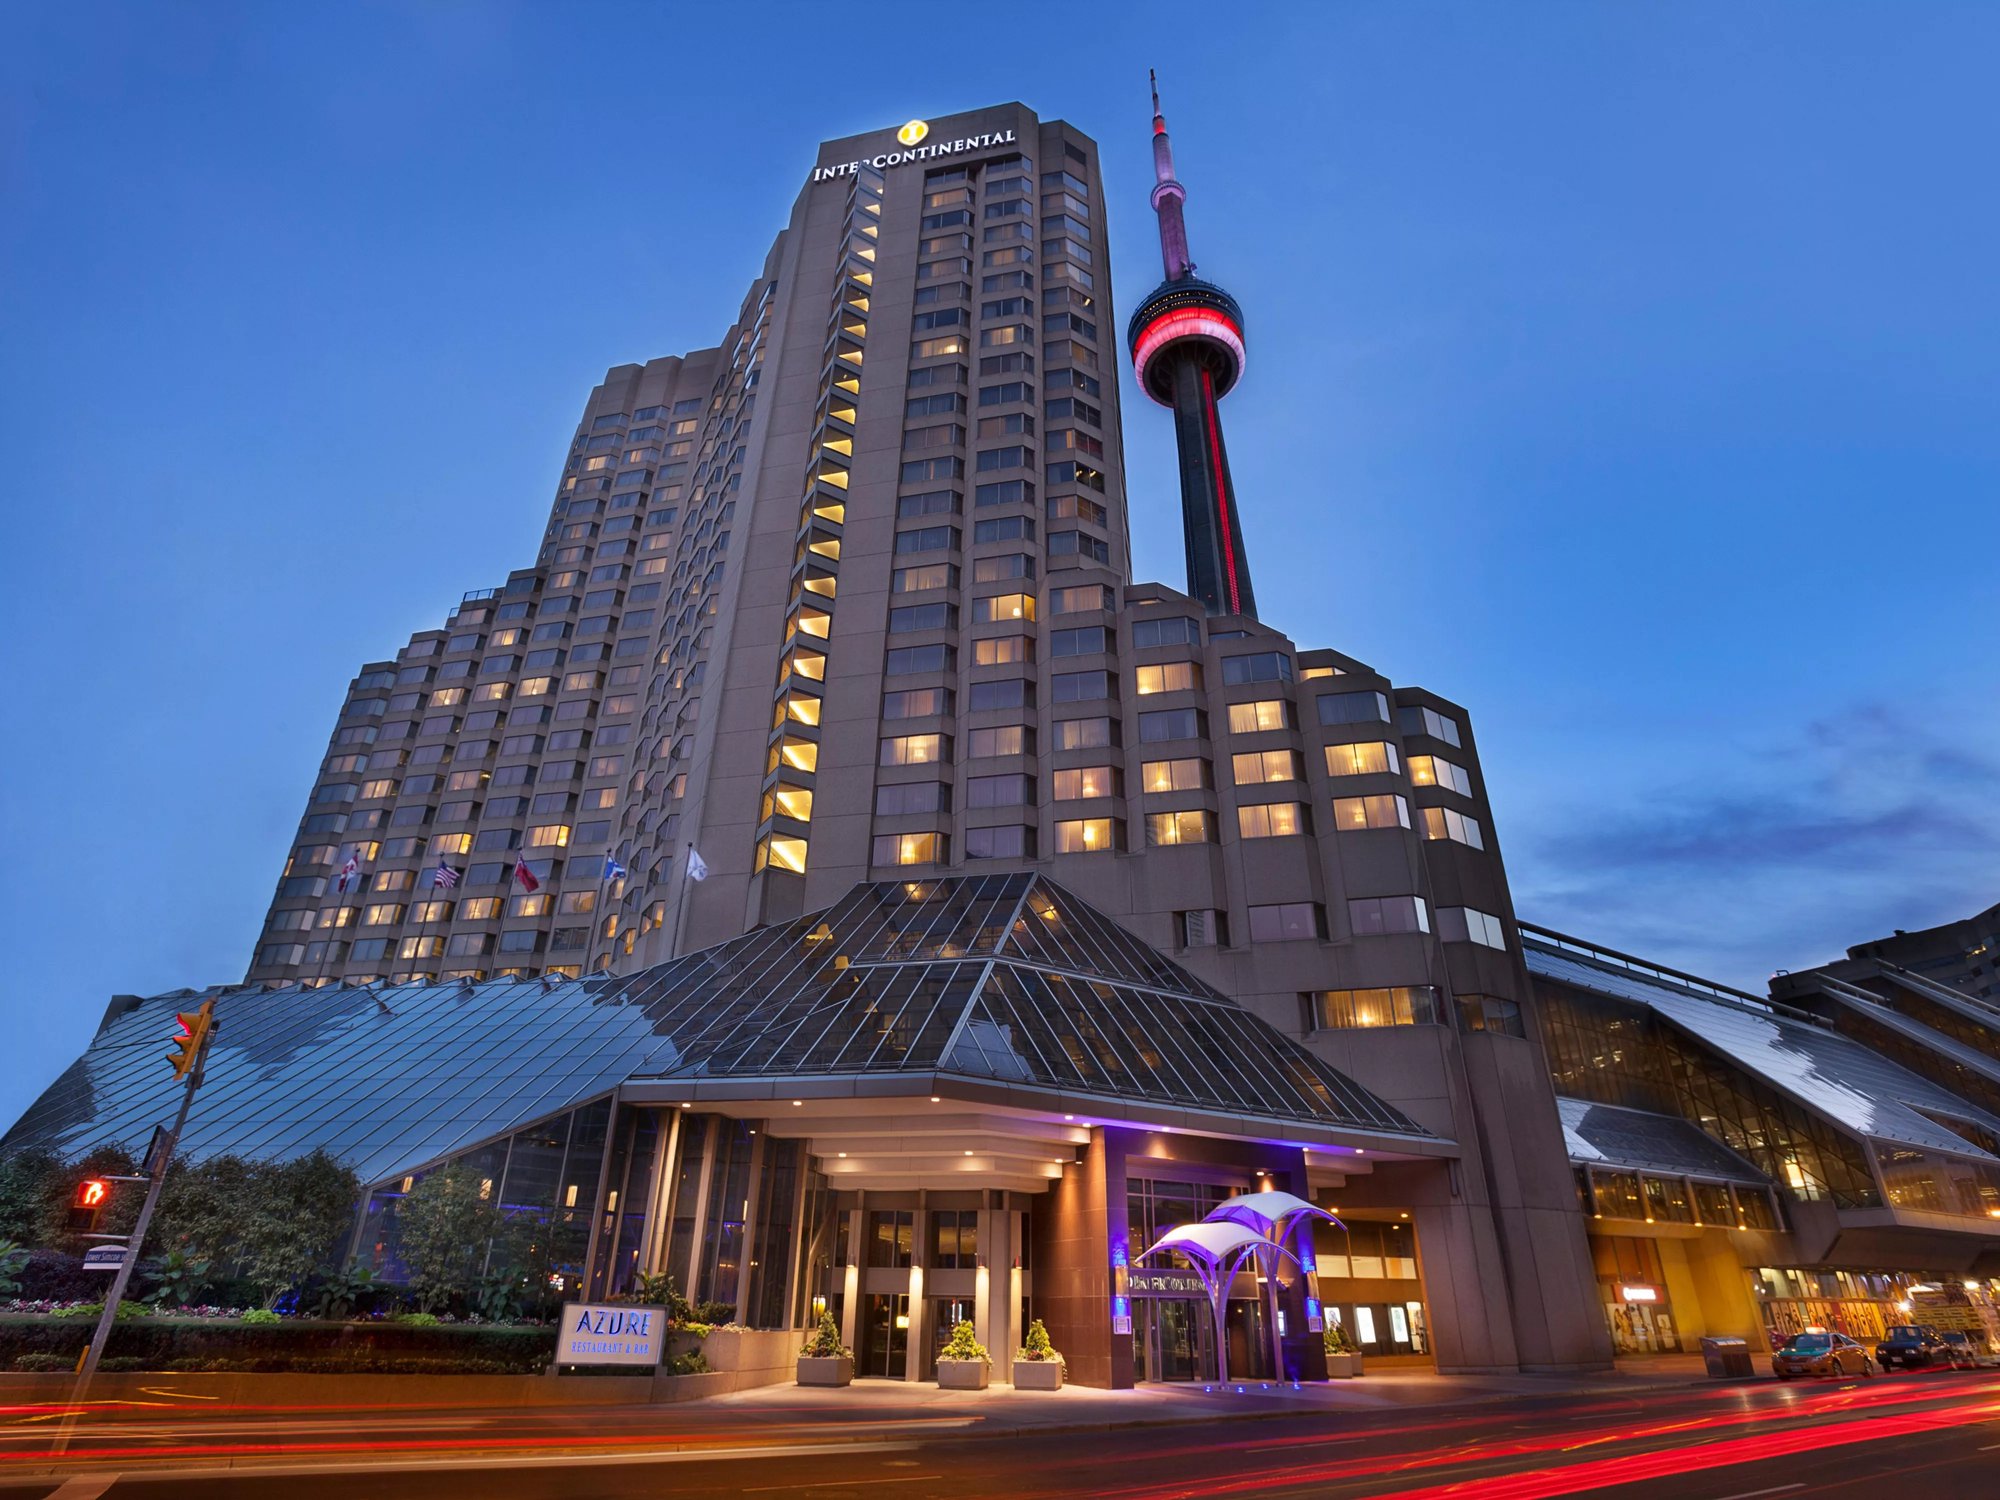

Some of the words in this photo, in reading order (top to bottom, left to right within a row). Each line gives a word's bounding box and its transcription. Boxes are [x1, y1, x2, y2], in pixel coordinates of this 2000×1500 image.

[576, 1310, 650, 1336] AZURE
[571, 1341, 623, 1353] RESTAURANT
[625, 1343, 631, 1354] &
[634, 1343, 649, 1354] BAR
